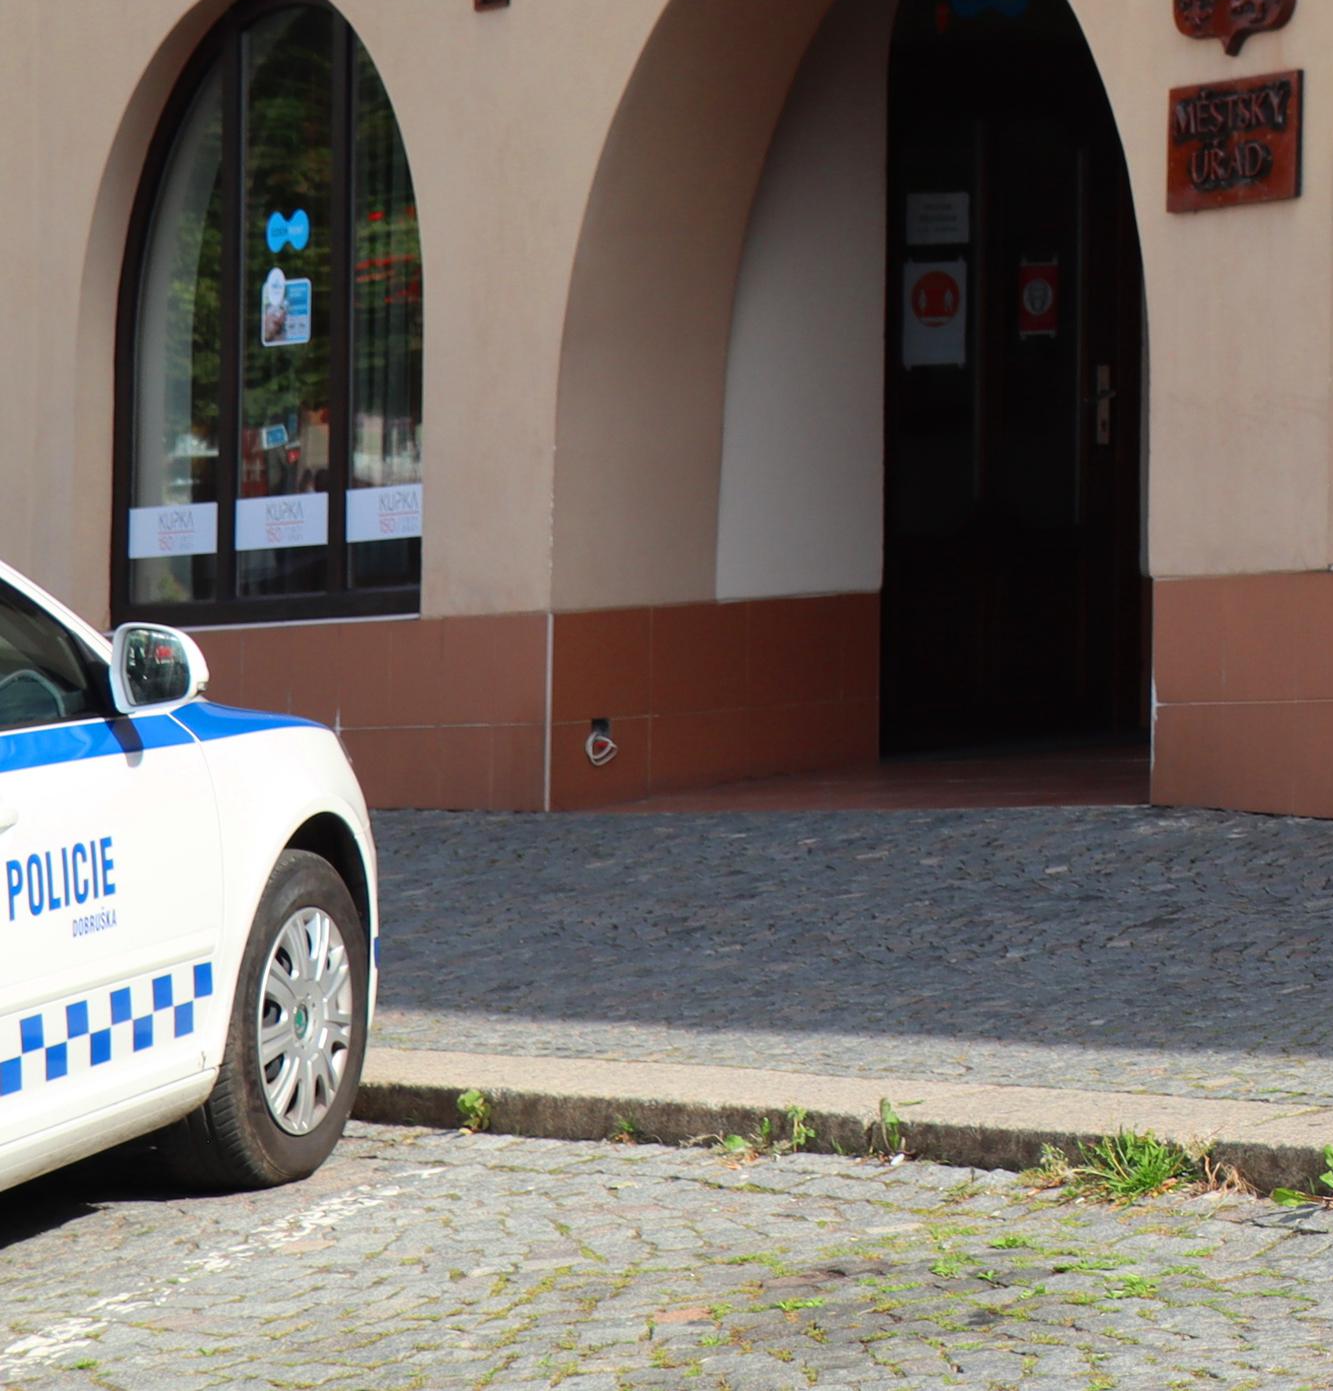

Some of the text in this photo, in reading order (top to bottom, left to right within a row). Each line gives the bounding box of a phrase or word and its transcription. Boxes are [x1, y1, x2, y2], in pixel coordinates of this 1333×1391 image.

[265, 500, 305, 521] KUPKA
[6, 836, 116, 922] POLICIE
[72, 907, 117, 938] DOBRUŠKA
